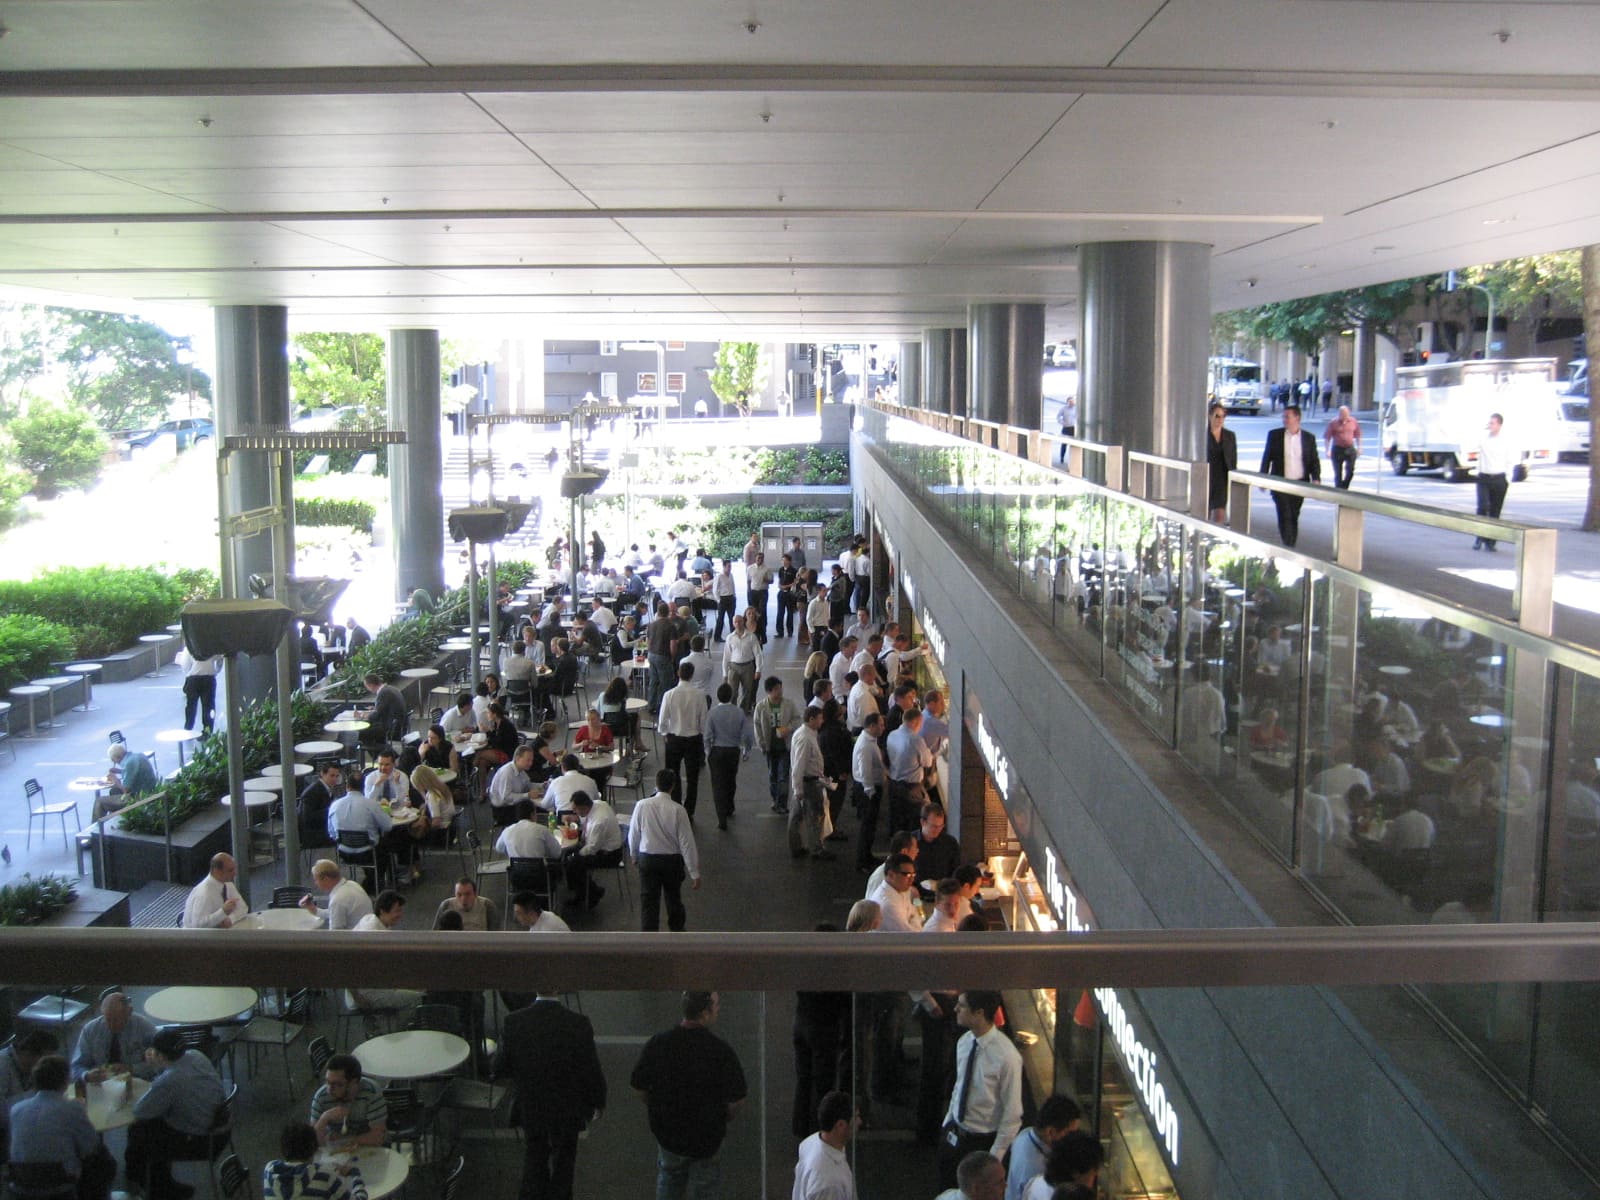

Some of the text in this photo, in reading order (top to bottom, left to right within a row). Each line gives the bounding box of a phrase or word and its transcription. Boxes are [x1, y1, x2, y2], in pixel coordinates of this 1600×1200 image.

[1045, 846, 1179, 1166] The Th onnection
